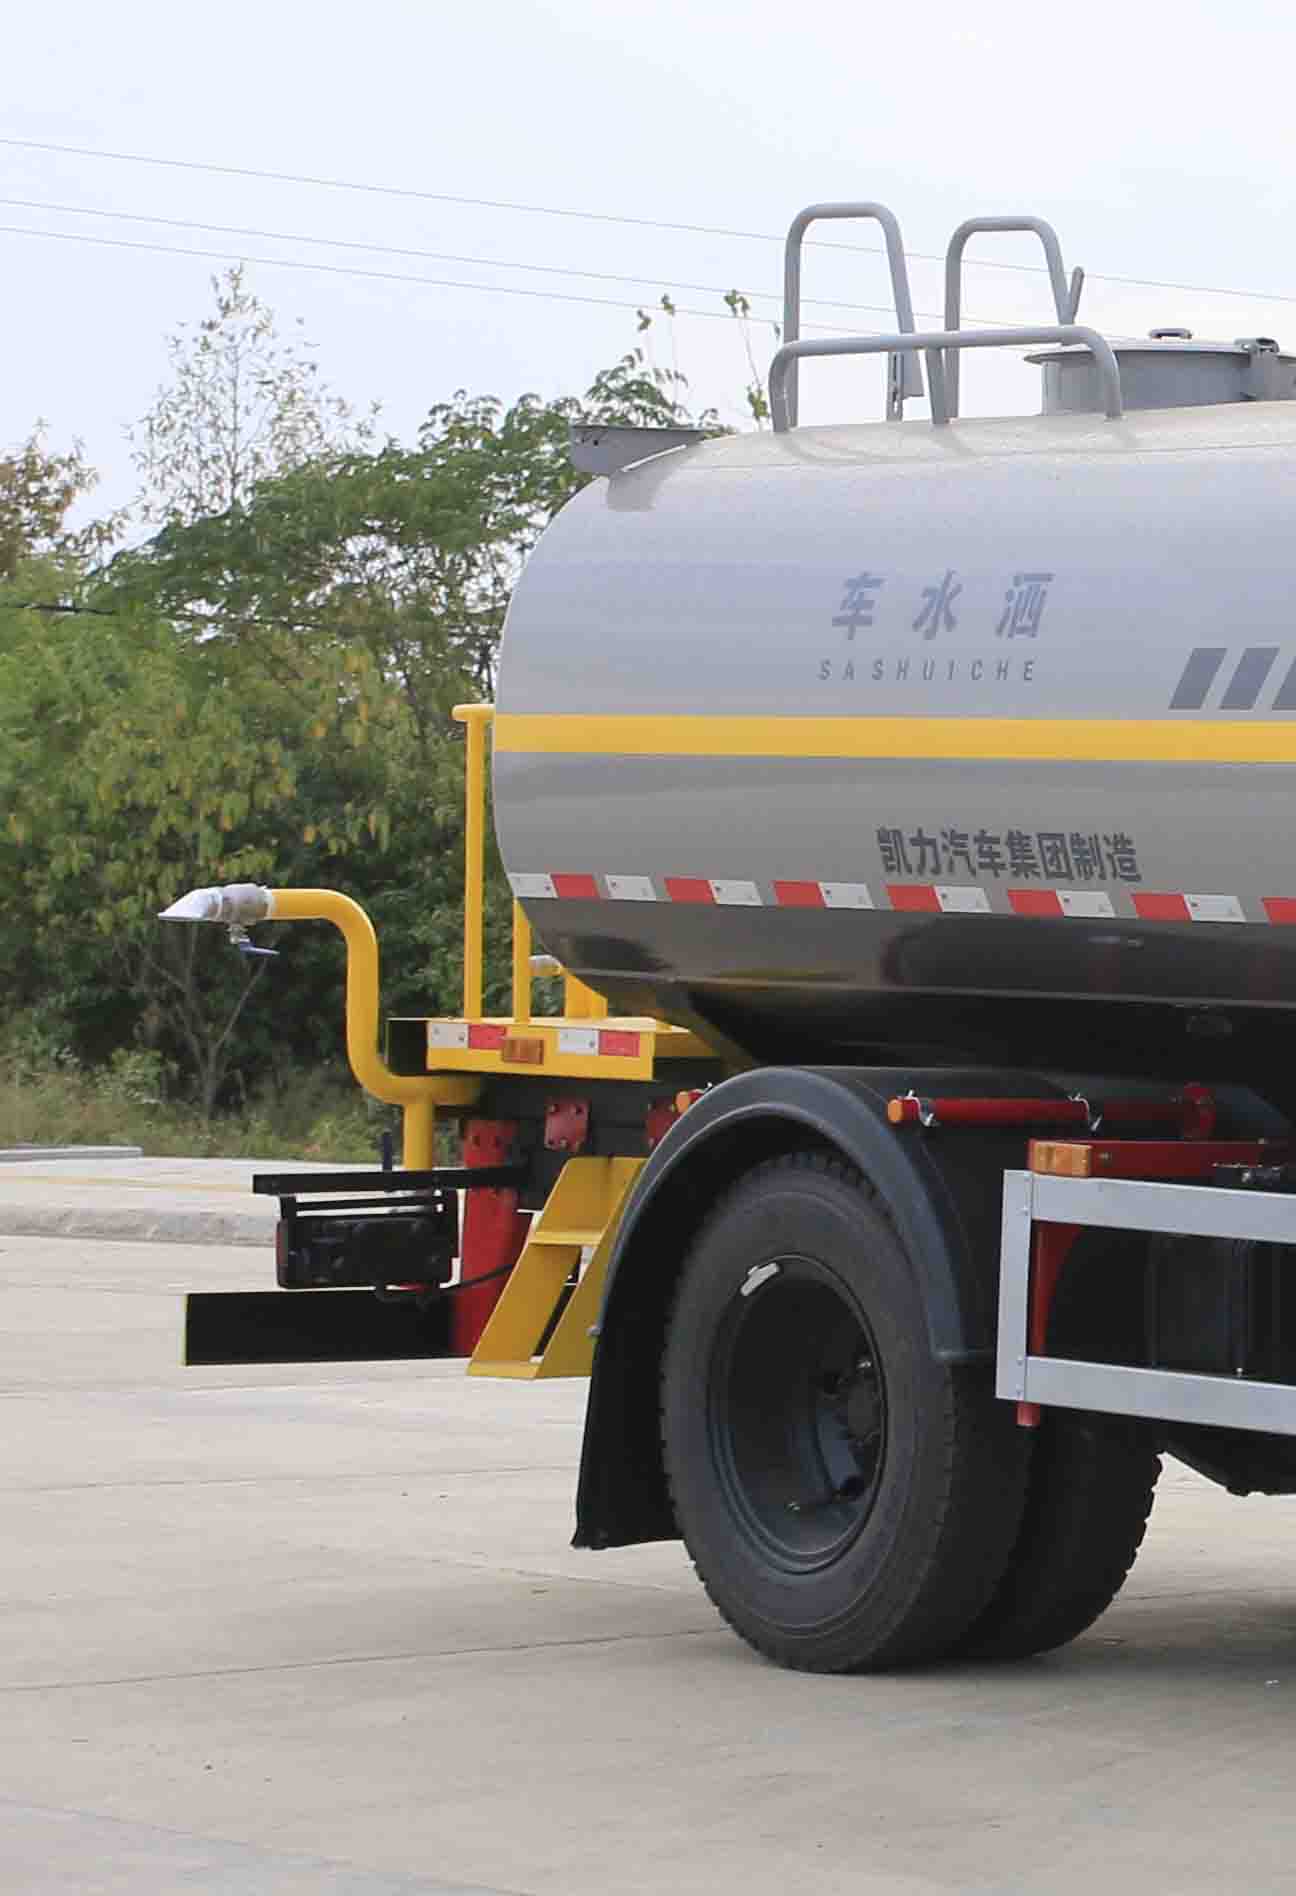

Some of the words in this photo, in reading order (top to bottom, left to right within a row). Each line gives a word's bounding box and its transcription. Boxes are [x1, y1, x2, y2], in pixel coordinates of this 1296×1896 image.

[817, 657, 1035, 681] SASHUICHE
[876, 827, 1141, 882] 凯力汽车集团制造
